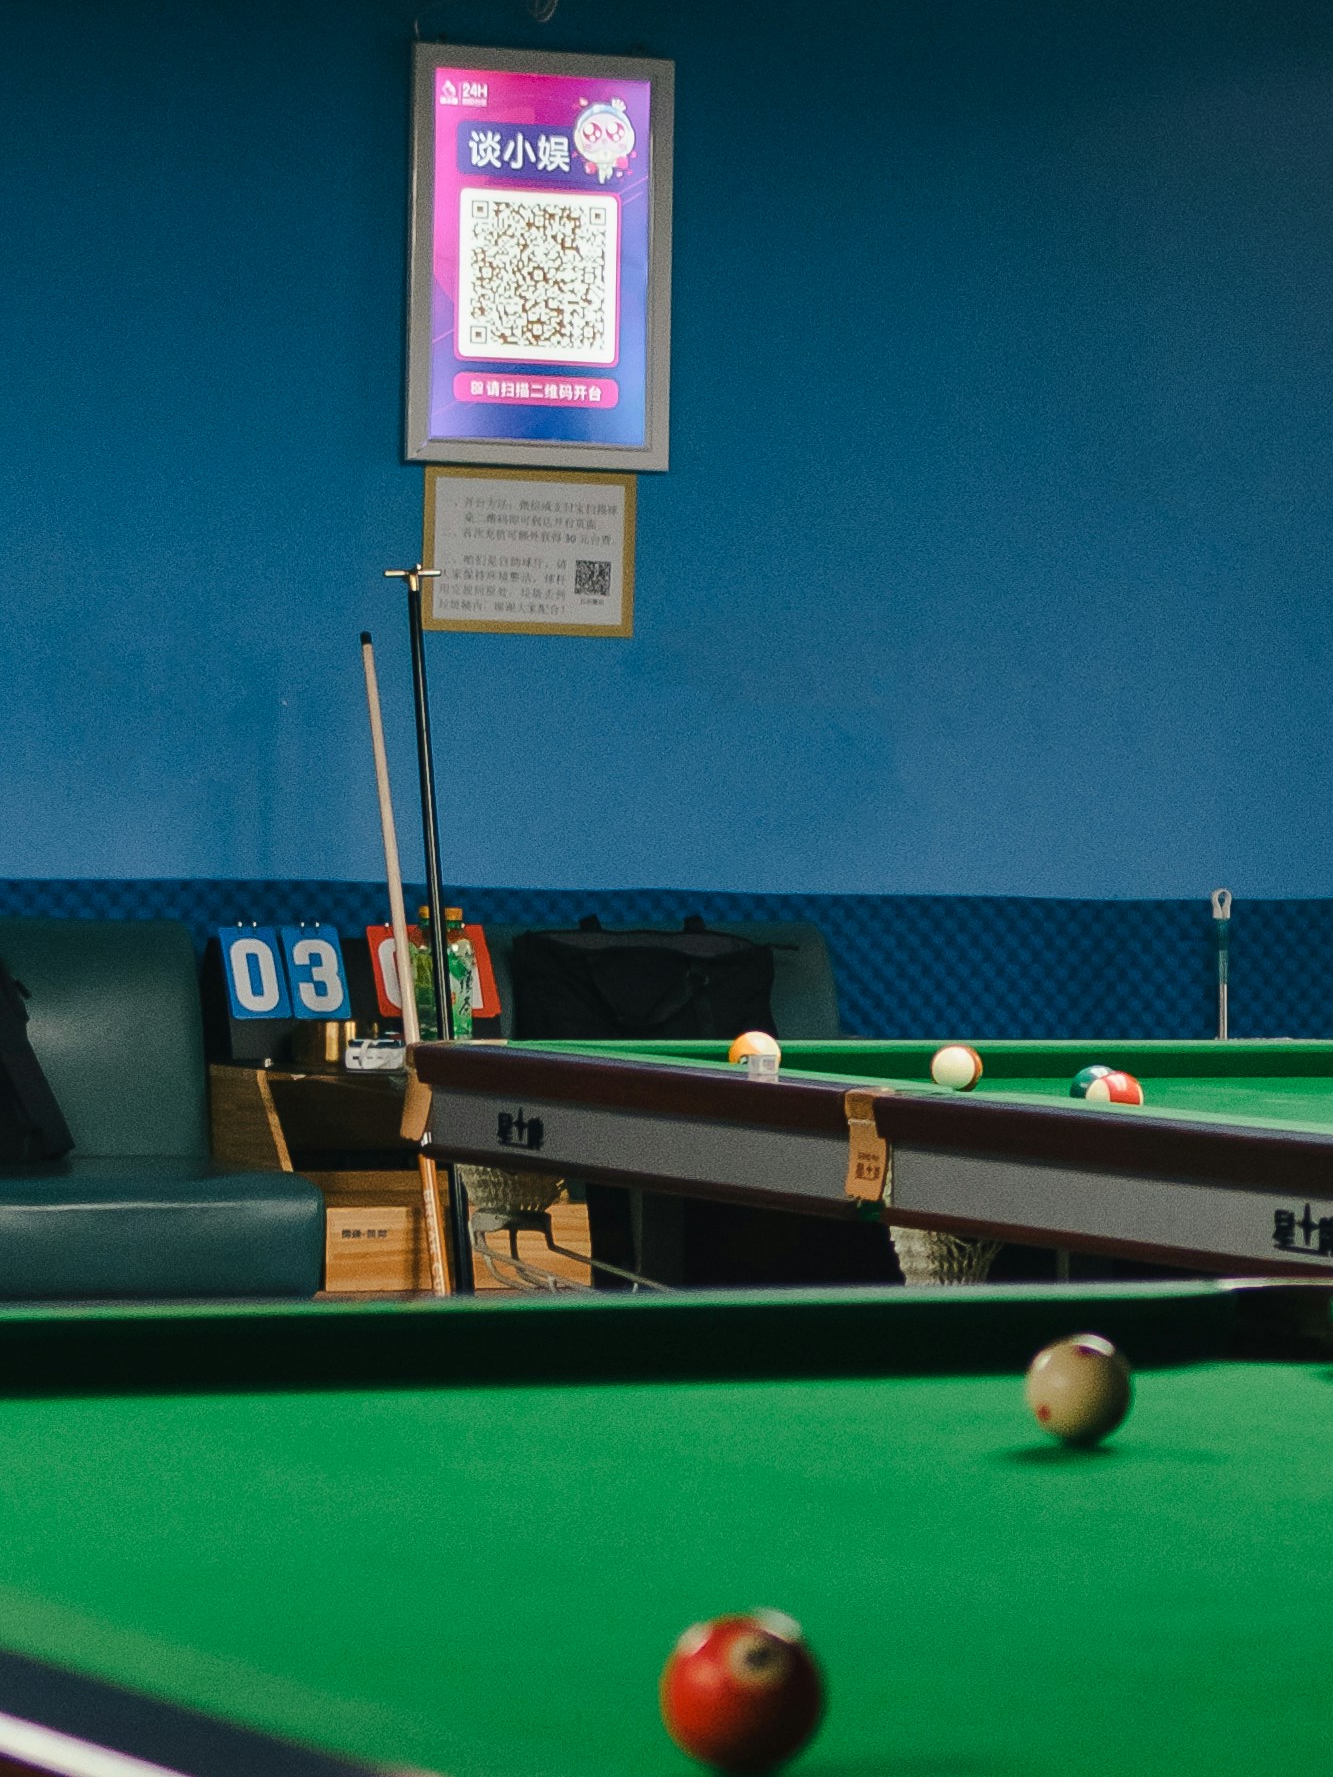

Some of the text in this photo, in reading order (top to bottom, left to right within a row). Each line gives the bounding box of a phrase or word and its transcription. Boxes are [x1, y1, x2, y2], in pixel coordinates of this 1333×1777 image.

[462, 82, 488, 98] 24H
[468, 129, 571, 173] 谈小娱
[487, 380, 602, 403] 请扫描二维码开台
